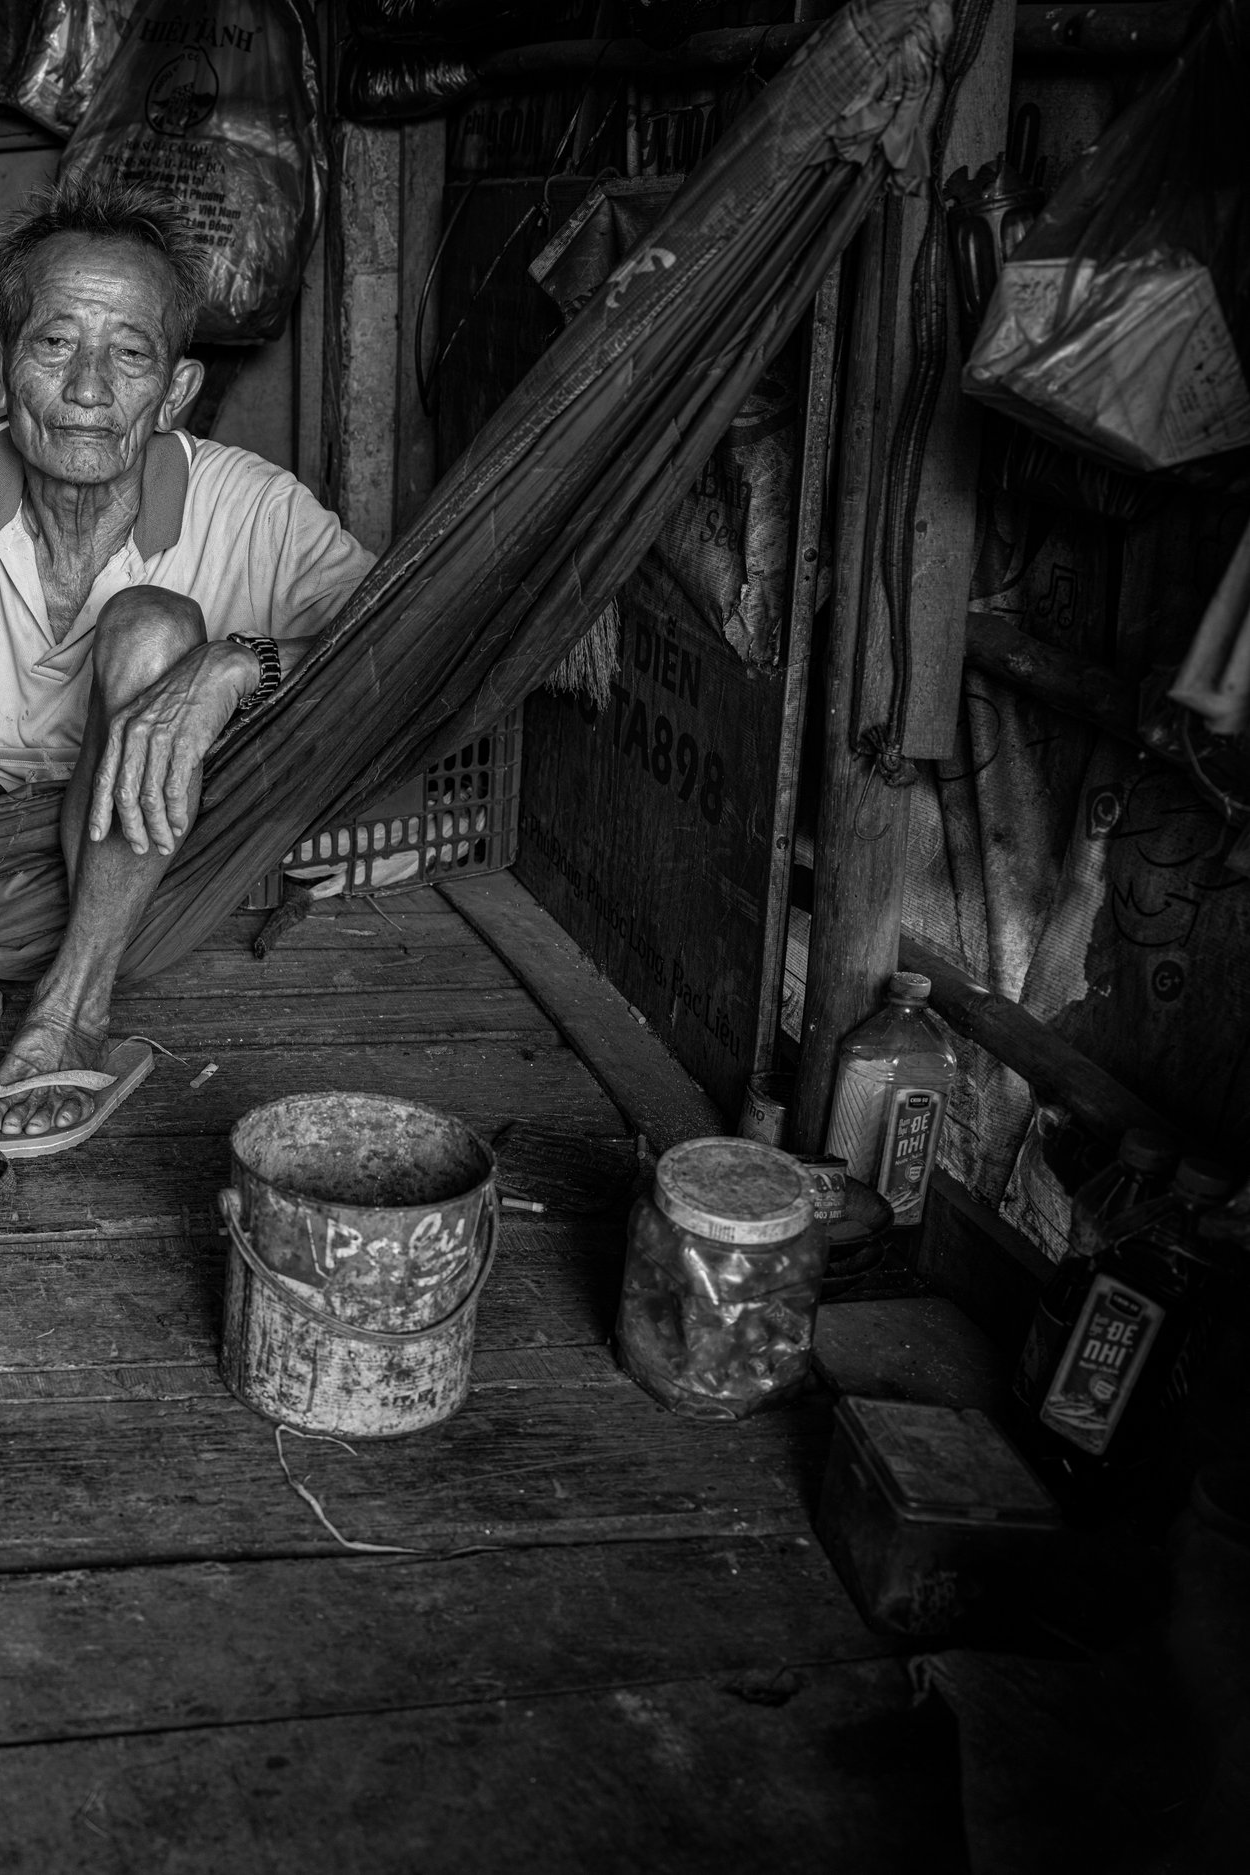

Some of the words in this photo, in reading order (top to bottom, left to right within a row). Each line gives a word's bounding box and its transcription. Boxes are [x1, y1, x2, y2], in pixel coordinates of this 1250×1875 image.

[218, 206, 241, 219] Nam
[610, 680, 725, 826] TA898
[704, 993, 741, 1061] Liêu
